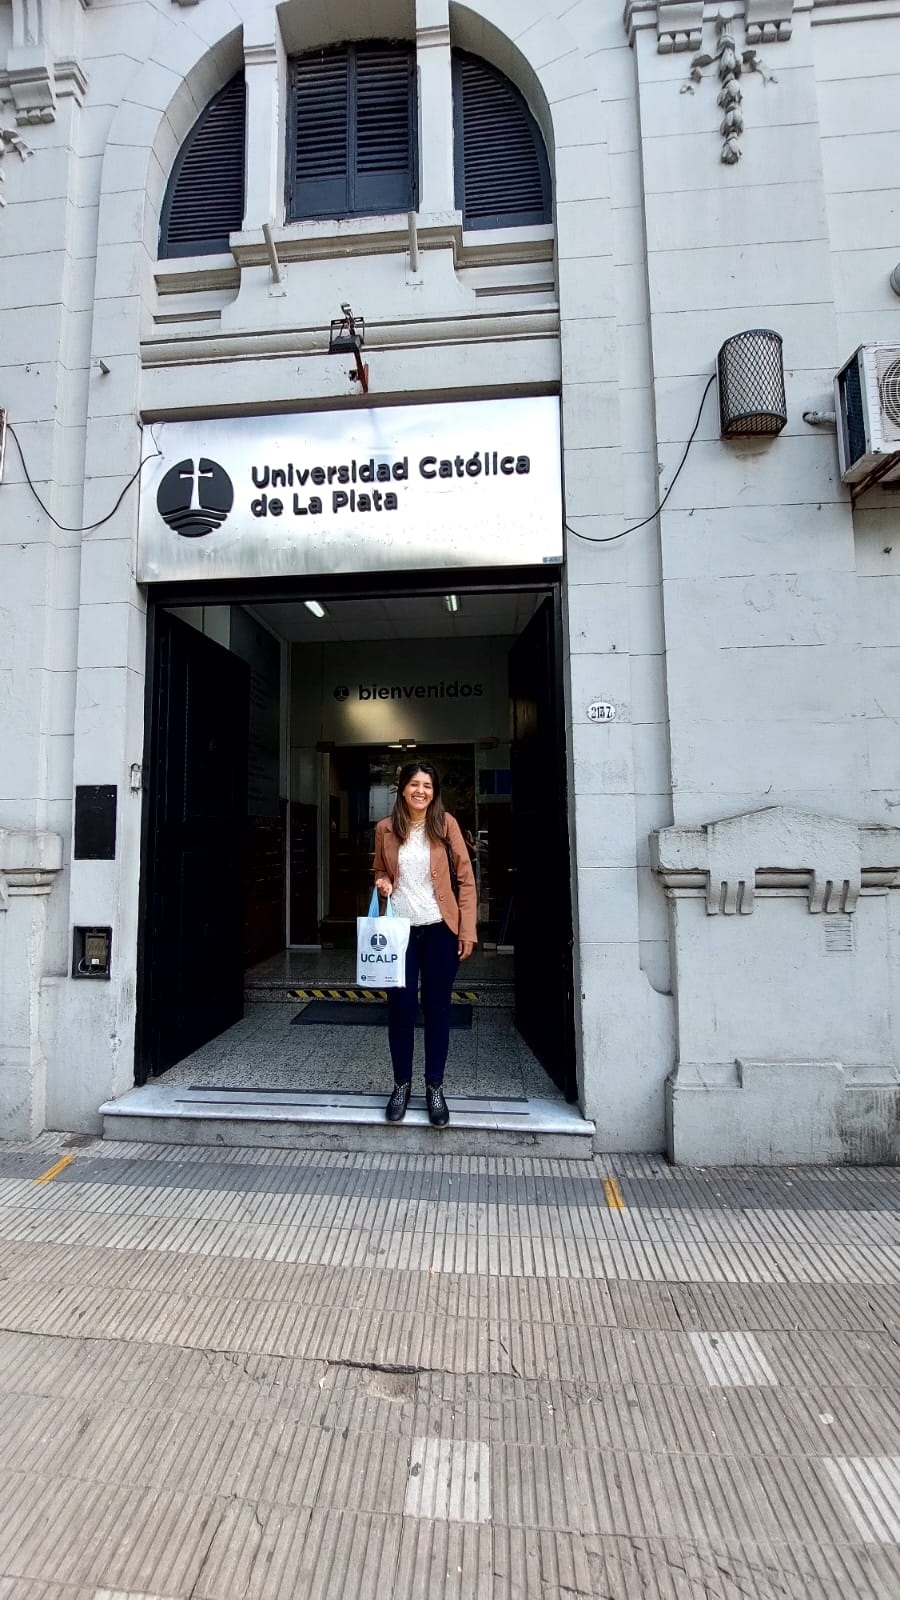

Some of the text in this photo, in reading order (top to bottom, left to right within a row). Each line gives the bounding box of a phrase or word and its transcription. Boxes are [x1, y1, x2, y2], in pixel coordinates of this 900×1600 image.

[251, 451, 530, 489] Universidad Católica
[250, 489, 398, 517] de La Plata
[358, 681, 483, 700] bienvenidos
[360, 953, 398, 963] UCALP
